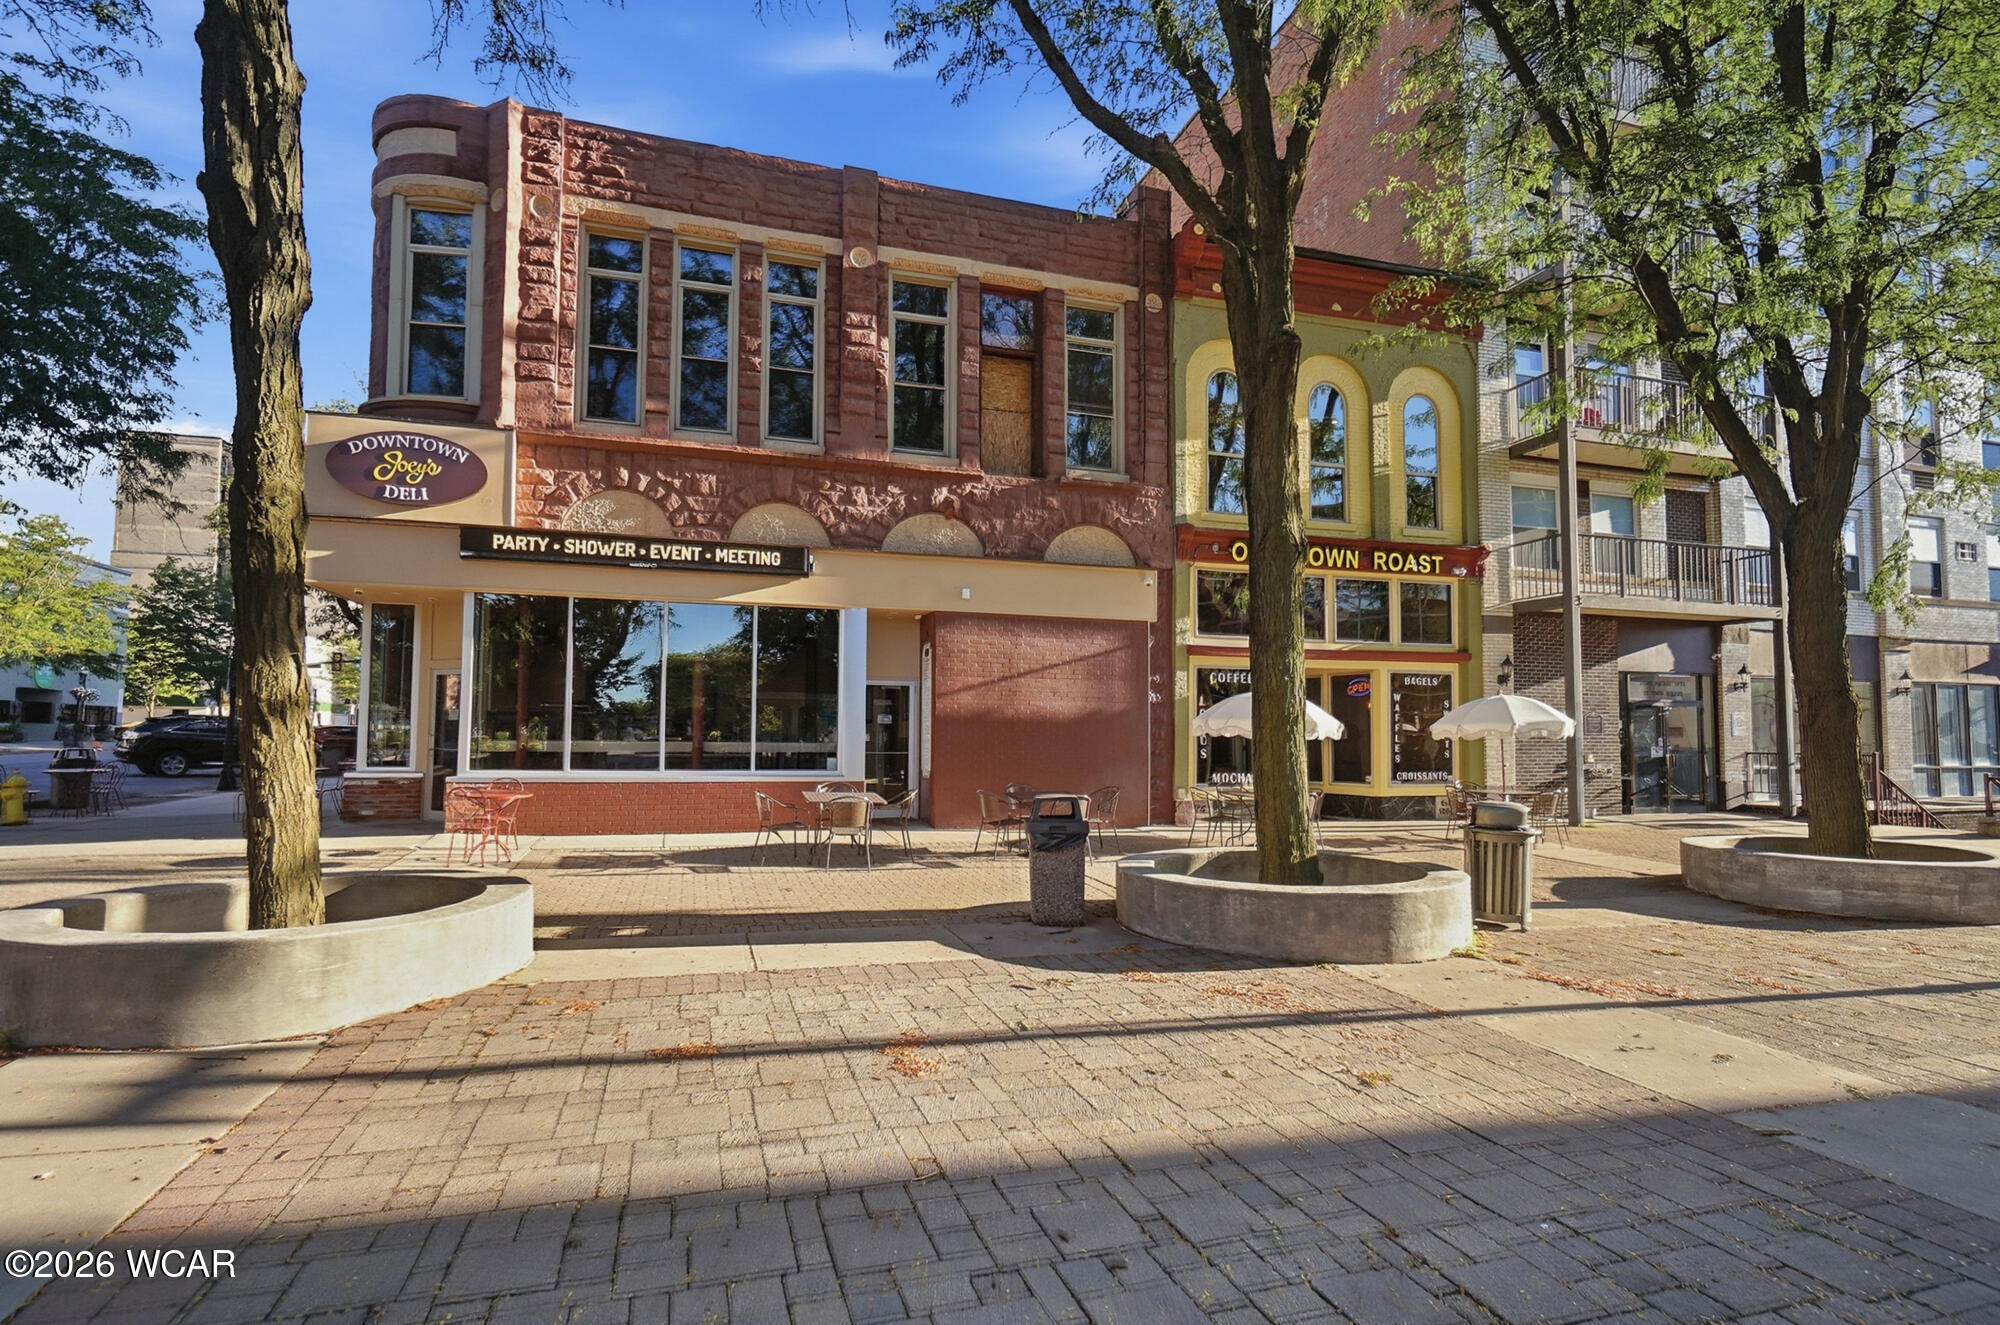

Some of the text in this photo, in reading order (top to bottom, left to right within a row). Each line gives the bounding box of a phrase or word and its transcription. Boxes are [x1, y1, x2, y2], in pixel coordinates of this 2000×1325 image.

[347, 434, 470, 463] DOWNTOWN
[373, 450, 442, 484] Joey's
[383, 484, 429, 501] DELI
[492, 534, 781, 566] PARTY SHOWER EVENT MEETING
[1309, 547, 1444, 574] OWN ROAST
[1404, 676, 1438, 686] BAGELS
[1396, 771, 1449, 781] CROISSANTS
